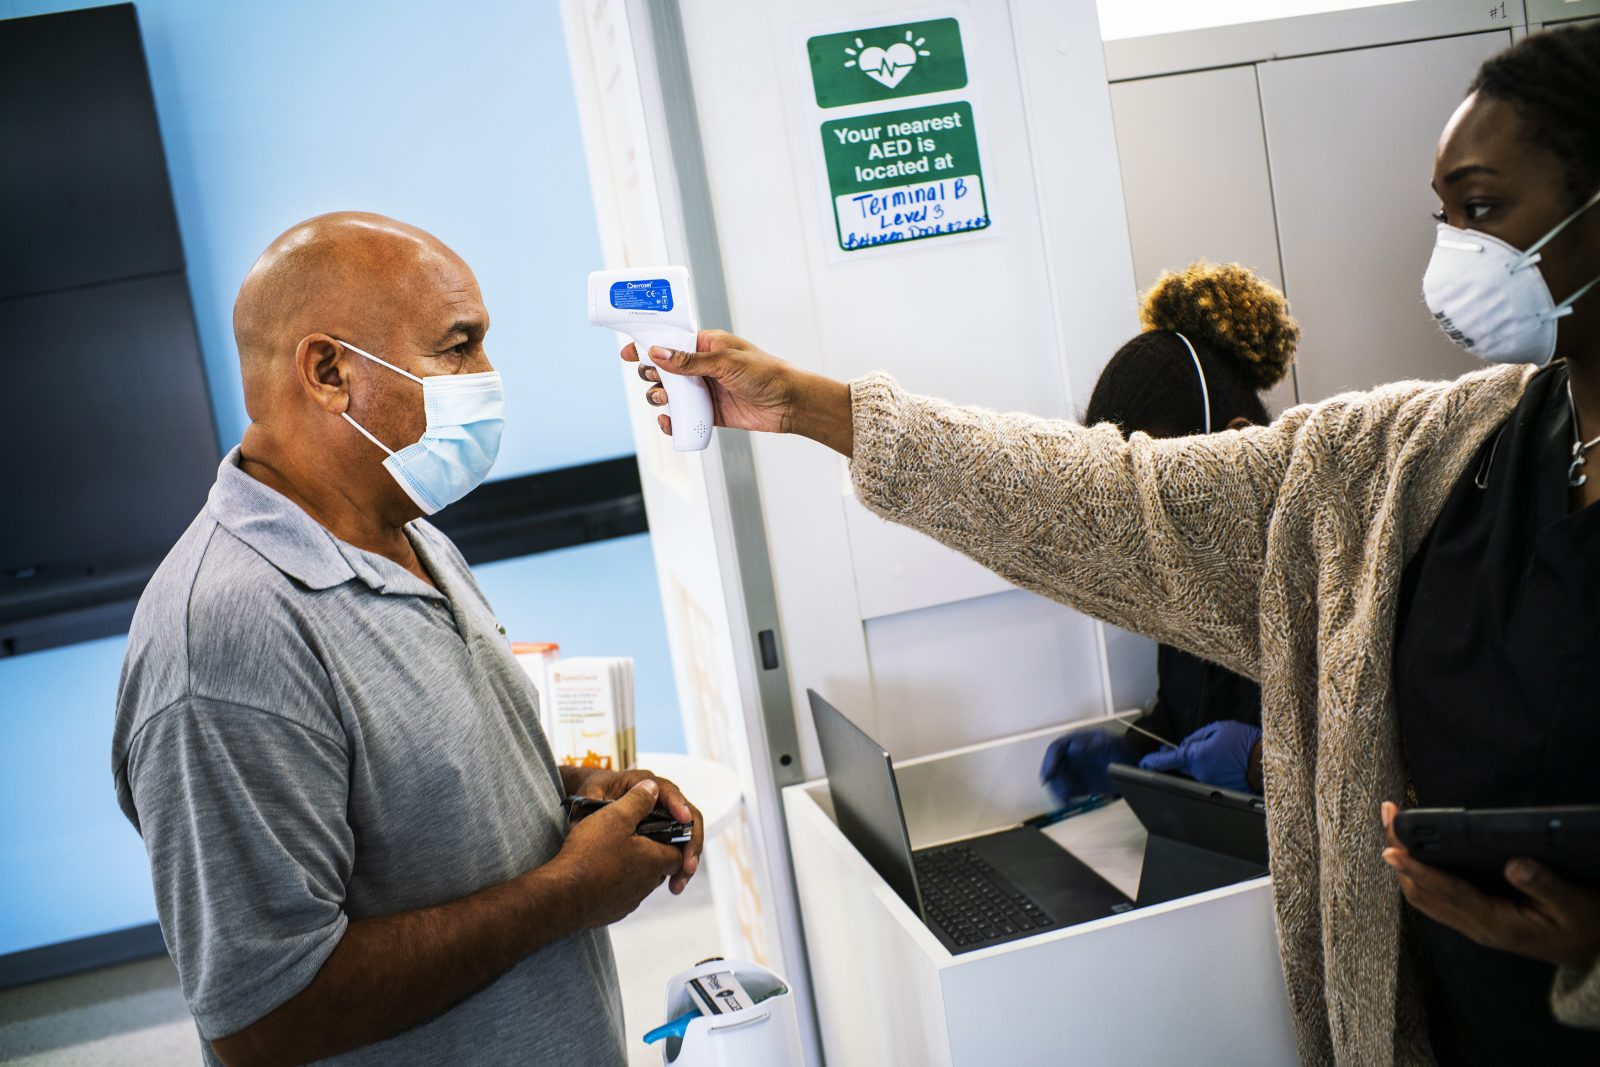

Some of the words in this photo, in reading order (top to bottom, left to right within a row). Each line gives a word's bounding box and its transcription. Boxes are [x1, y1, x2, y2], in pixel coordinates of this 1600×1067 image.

[1489, 1, 1507, 19] #1
[834, 126, 882, 145] Your
[887, 112, 962, 138] nearest
[868, 138, 912, 160] AED
[917, 137, 936, 153] is
[855, 156, 929, 182] located
[934, 153, 954, 170] at
[852, 183, 945, 218] Terminal
[954, 178, 968, 200] B
[880, 205, 927, 229] Level
[933, 204, 944, 219] 3
